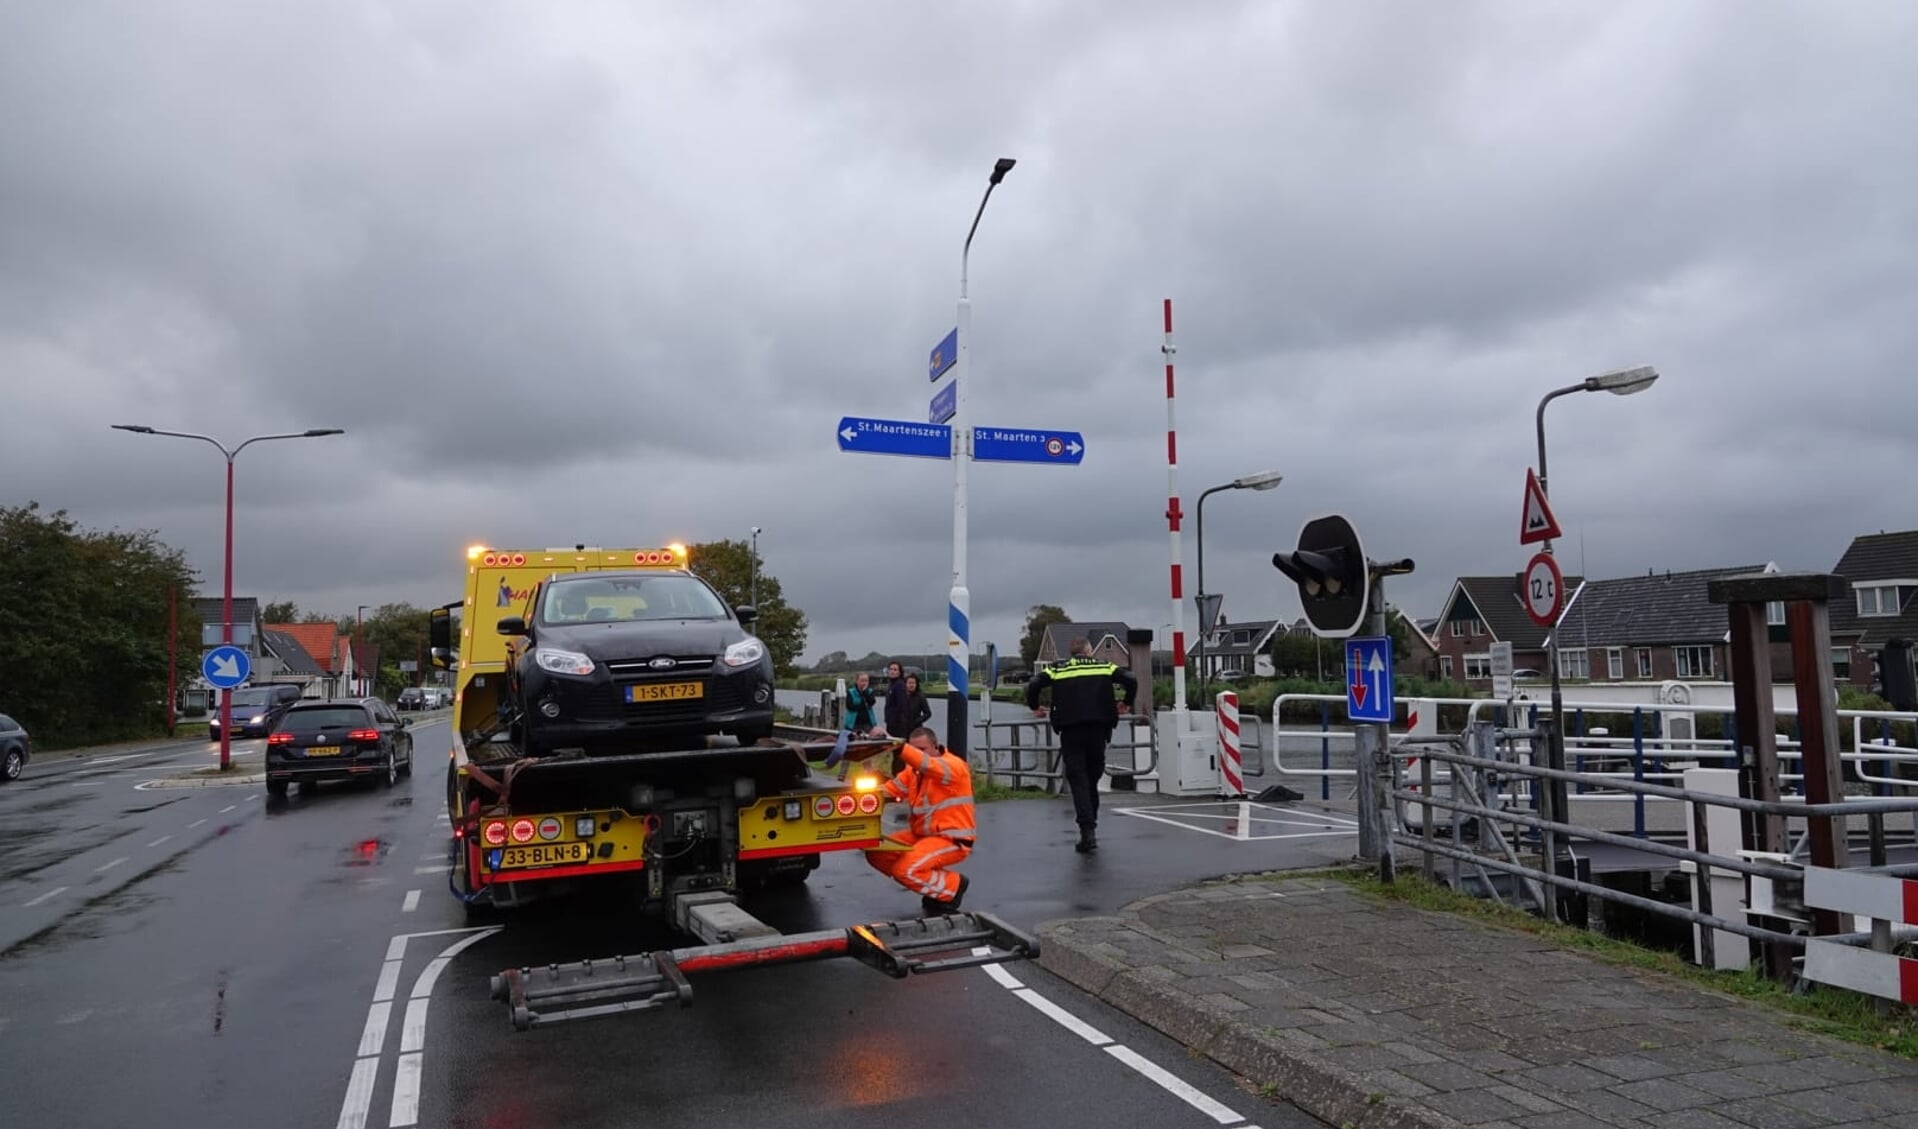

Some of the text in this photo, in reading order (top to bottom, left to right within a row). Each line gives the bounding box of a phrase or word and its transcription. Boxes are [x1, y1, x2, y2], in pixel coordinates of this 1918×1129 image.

[976, 430, 991, 441] St.
[994, 432, 1037, 443] Maarten
[1530, 578, 1543, 600] 12
[640, 684, 696, 699] 1-SKT-73
[506, 845, 581, 865] 33-BLN-8
